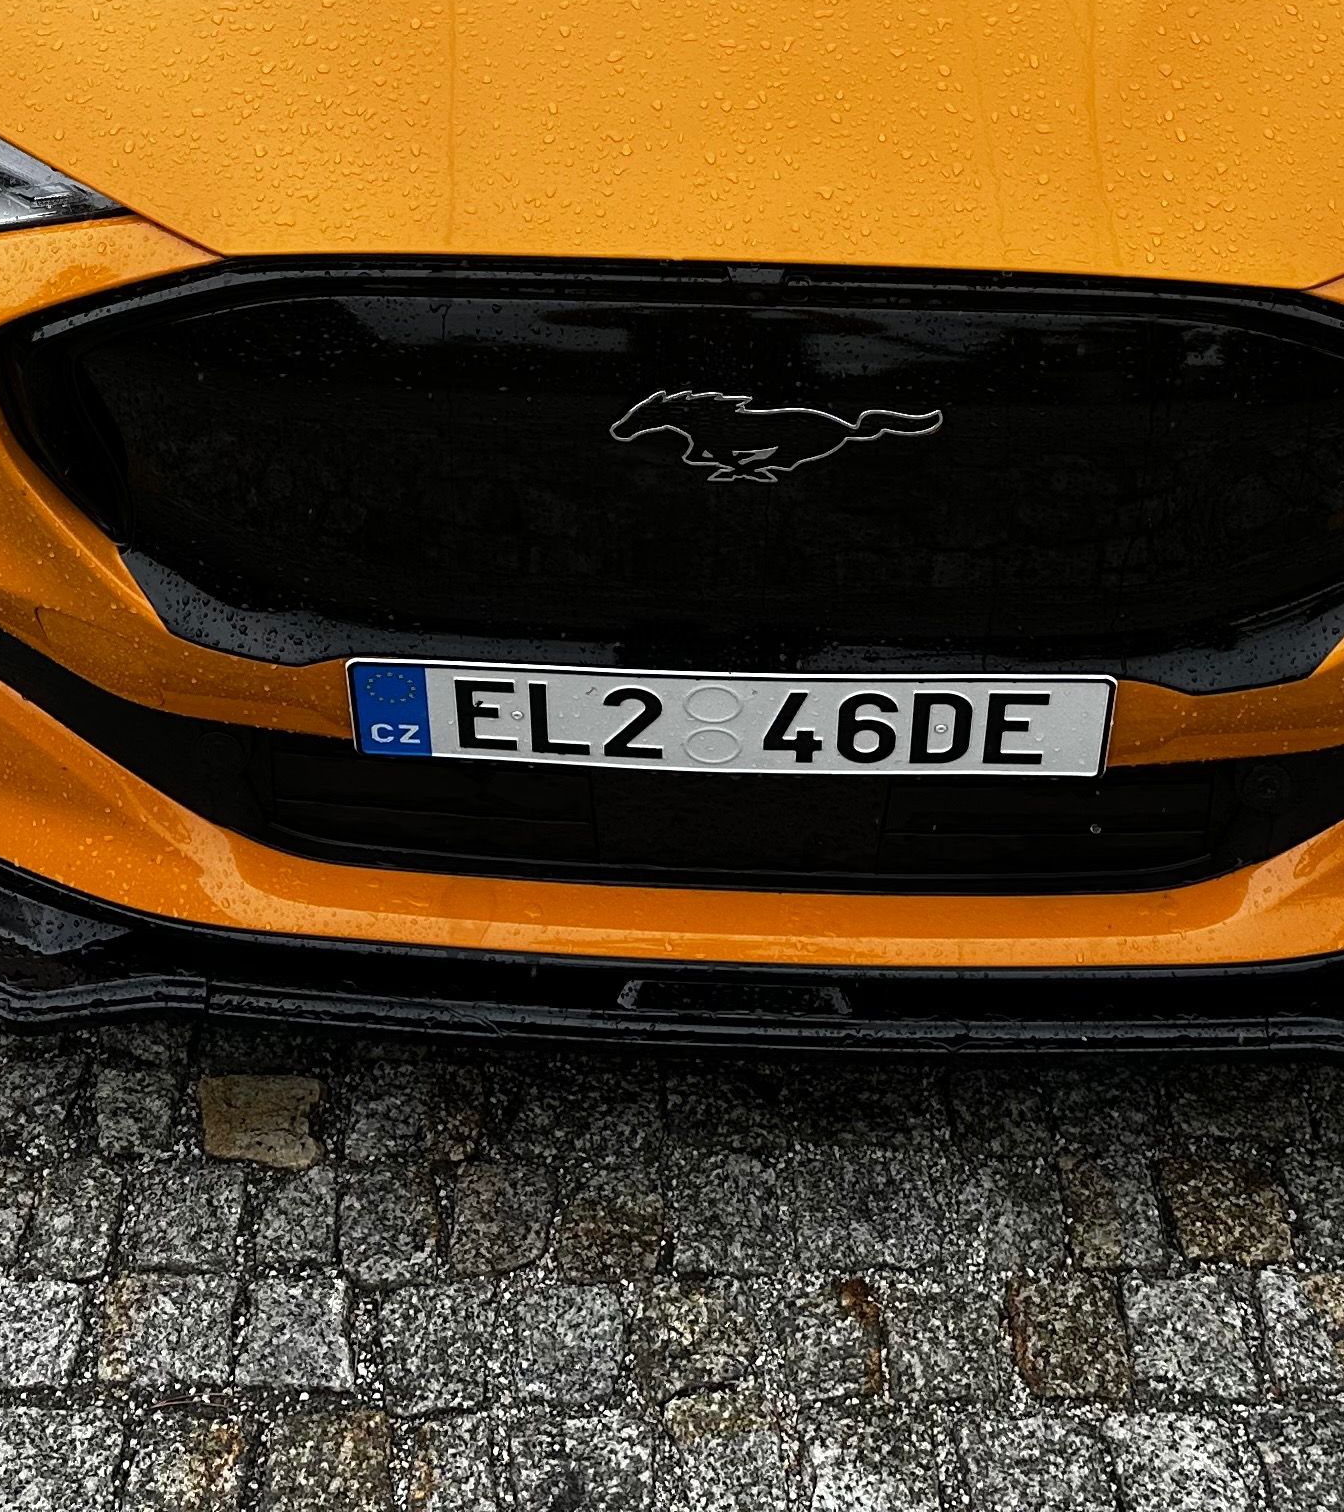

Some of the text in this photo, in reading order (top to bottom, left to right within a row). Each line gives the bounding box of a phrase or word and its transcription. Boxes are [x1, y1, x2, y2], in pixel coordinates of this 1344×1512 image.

[371, 723, 421, 744] CZ
[454, 678, 1051, 764] EL2 46DE
